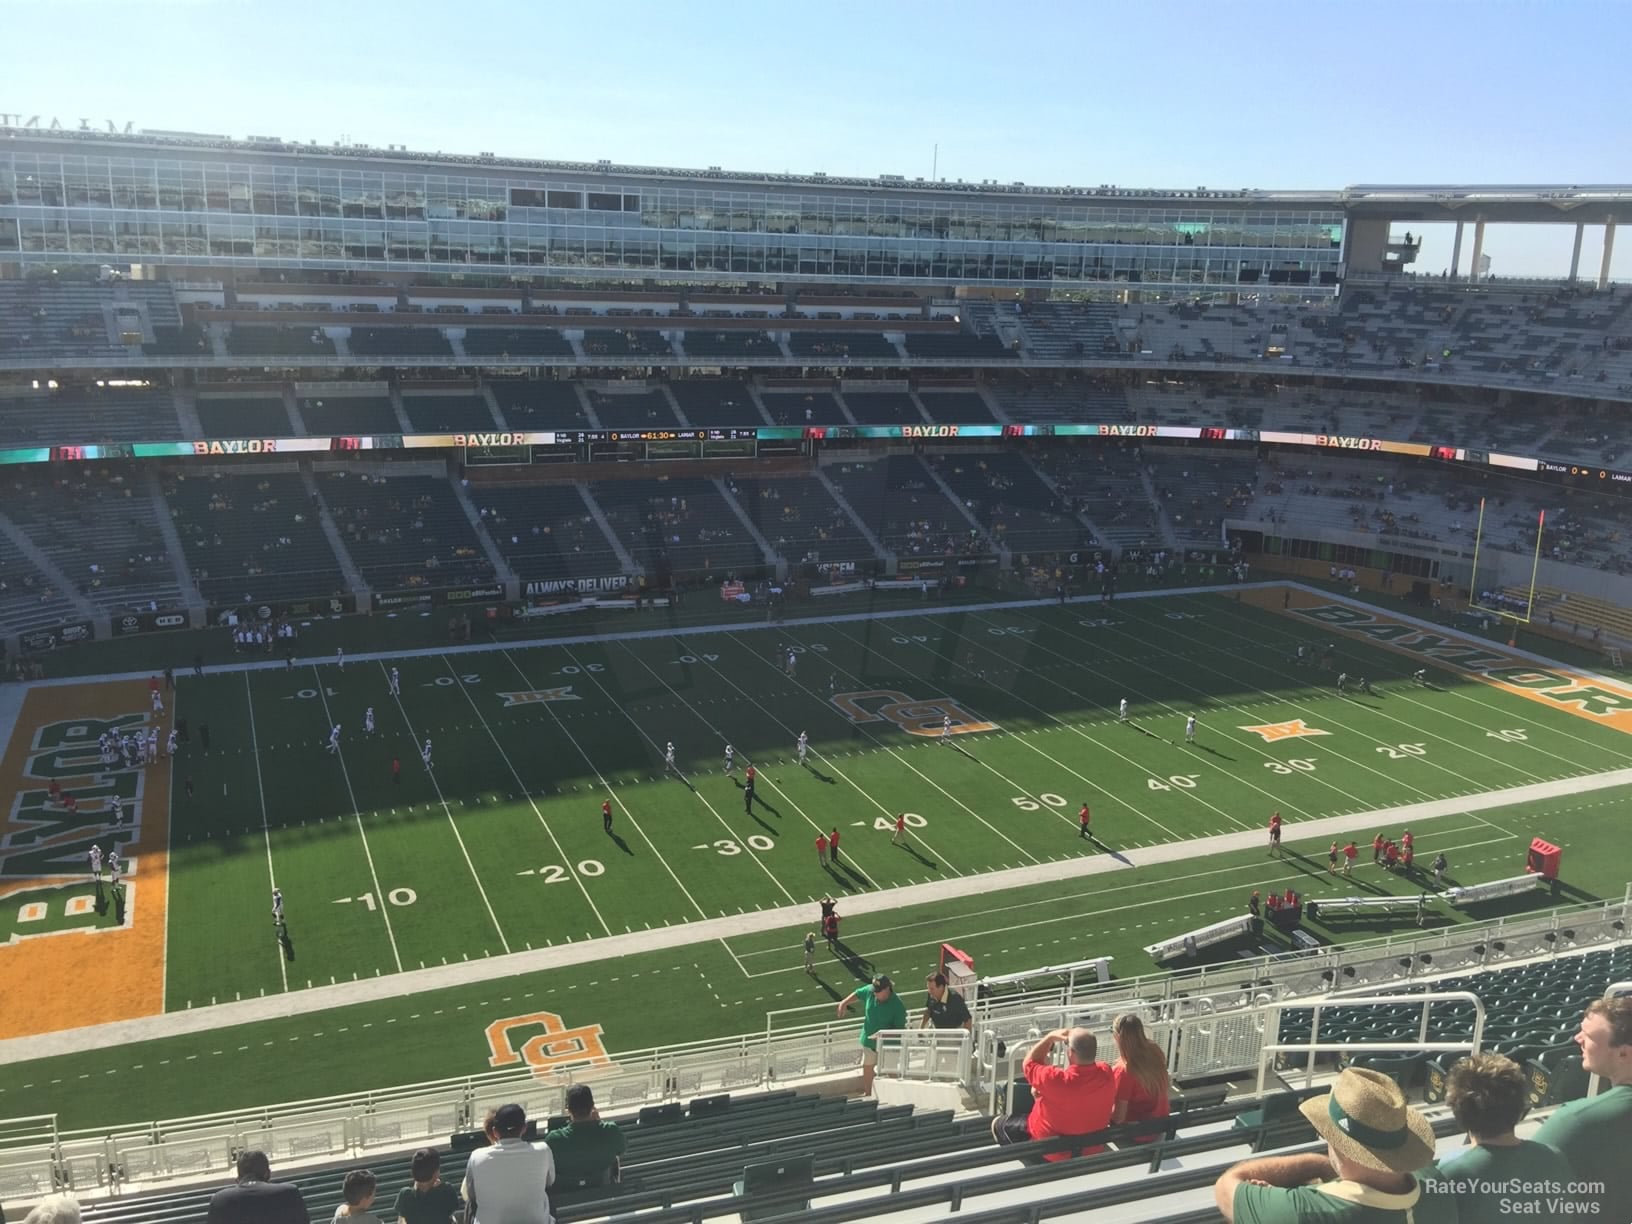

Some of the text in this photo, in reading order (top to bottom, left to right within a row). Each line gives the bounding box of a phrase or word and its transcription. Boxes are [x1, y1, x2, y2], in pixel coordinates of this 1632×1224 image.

[902, 425, 960, 437] BAYLOR
[1099, 425, 1158, 437] BAYLOR
[193, 439, 276, 455] BAYLOR
[454, 433, 525, 447] BAYLOR
[1316, 435, 1382, 451] BAYLOR
[1546, 464, 1567, 472] BAYLOR
[1611, 474, 1632, 482] LAMAR
[526, 576, 627, 594] ALWAYS DELIVER
[1285, 604, 1632, 717] BAYLOR
[1012, 793, 1067, 811] 50
[0, 711, 151, 948] BAYLOR
[714, 835, 775, 857] 30
[539, 859, 605, 884] 20
[356, 887, 417, 911] 10
